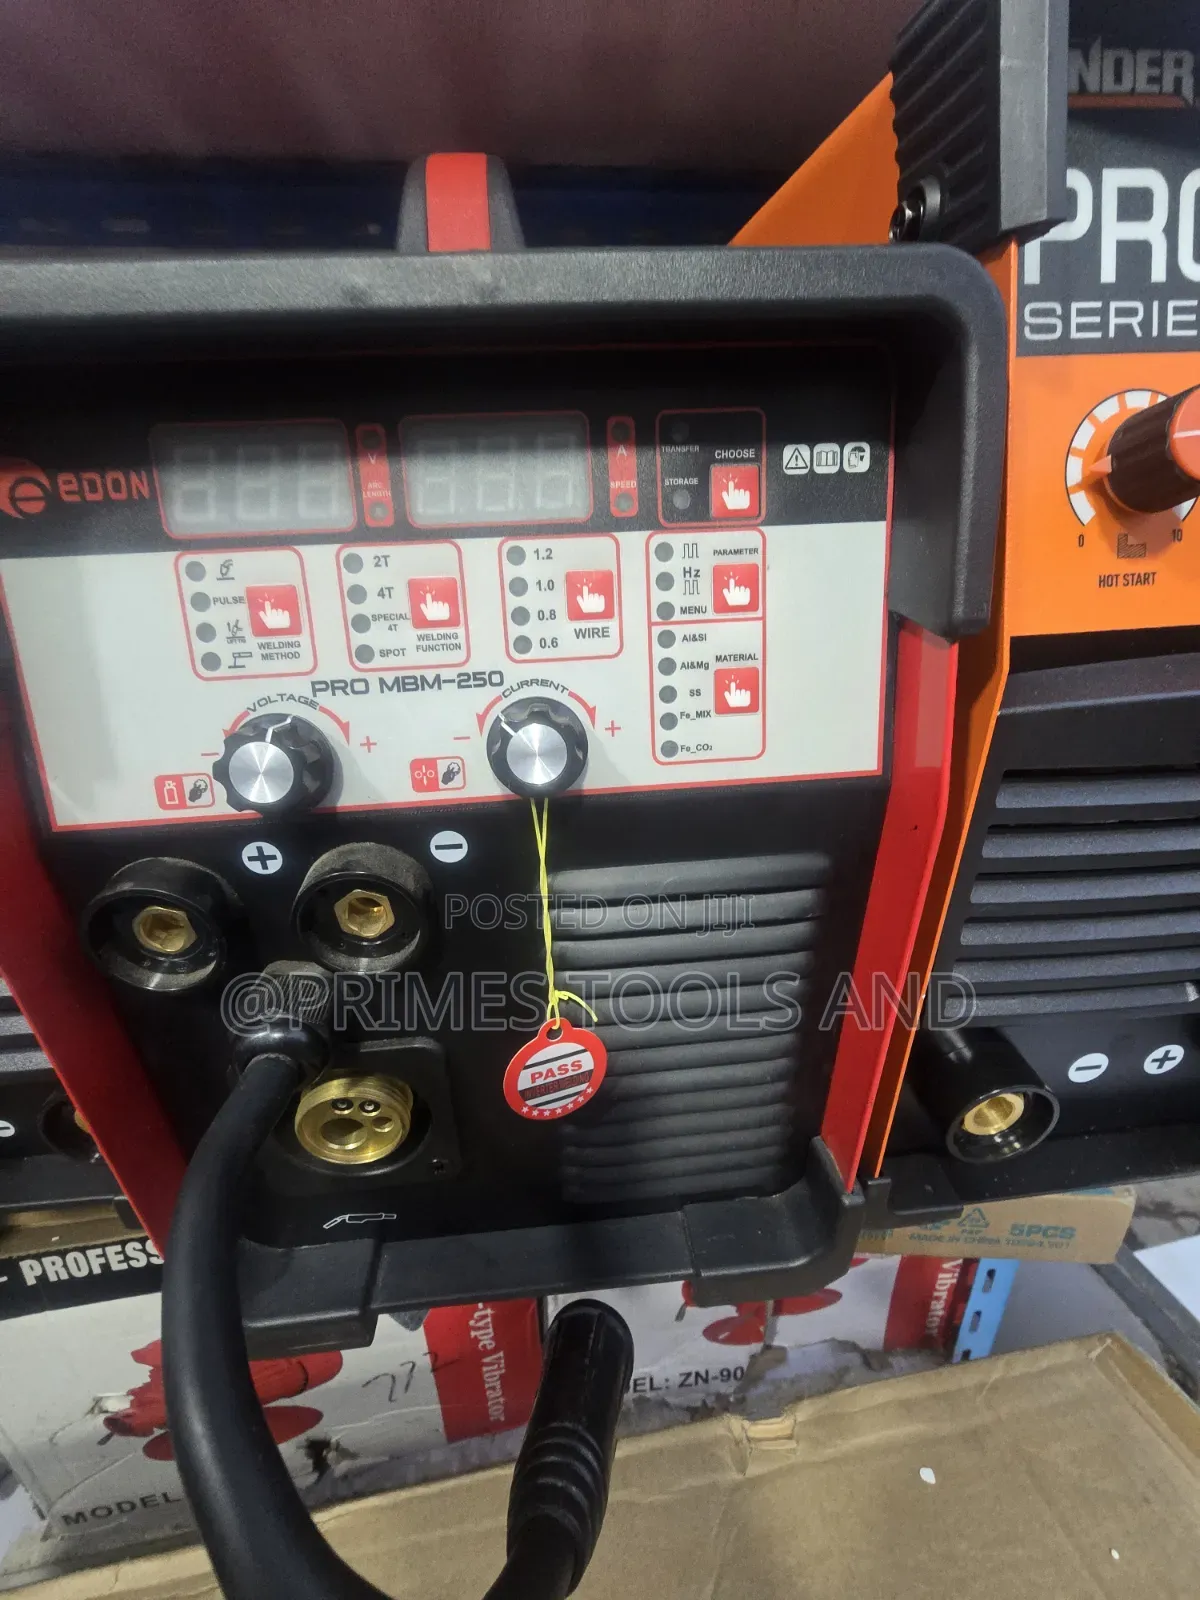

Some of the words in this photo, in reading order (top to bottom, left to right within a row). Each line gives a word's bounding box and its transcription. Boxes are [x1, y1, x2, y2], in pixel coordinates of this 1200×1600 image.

[661, 444, 700, 453] TRANSFER
[714, 448, 756, 459] CHOOSE
[610, 479, 637, 489] SPEED
[664, 477, 699, 486] STORAGE
[1078, 534, 1085, 547] 0
[1171, 528, 1183, 542] 10
[533, 547, 553, 560] 1.2
[713, 547, 759, 556] PARAMETER
[373, 554, 391, 568] 2T
[683, 566, 701, 578] Hz
[536, 579, 555, 591] 1.0
[1098, 573, 1120, 588] HOT
[1122, 571, 1157, 587] START
[377, 586, 394, 599] 4T
[212, 595, 246, 606] PULSE
[537, 609, 556, 621] 0.8
[680, 605, 707, 615] MENU
[371, 612, 411, 622] SPECIAL
[388, 623, 398, 632] 4T
[574, 626, 610, 639] WIRE
[417, 632, 459, 642] WELDING
[539, 637, 559, 649] 0.6
[257, 640, 301, 650] WELDING
[416, 642, 462, 652] FUNCTION
[261, 651, 301, 661] METHOD
[379, 648, 406, 658] SPOT
[715, 653, 759, 663] MATERIAL
[310, 677, 370, 698] PRO
[378, 670, 504, 694] MBM-250
[502, 678, 569, 699] CURRENT
[689, 688, 702, 697] SS
[246, 693, 320, 713] VOLTAGE
[680, 710, 712, 720] Fe_MIX
[530, 1060, 583, 1085] PASS
[1009, 1223, 1076, 1239] 5PCS
[19, 1239, 165, 1286] PROFESS
[925, 1258, 963, 1337] Vibrator
[629, 1376, 671, 1394] EL:
[678, 1365, 745, 1389] ZN-90
[481, 1350, 506, 1422] Vibrator
[61, 1491, 182, 1526] MODEL
